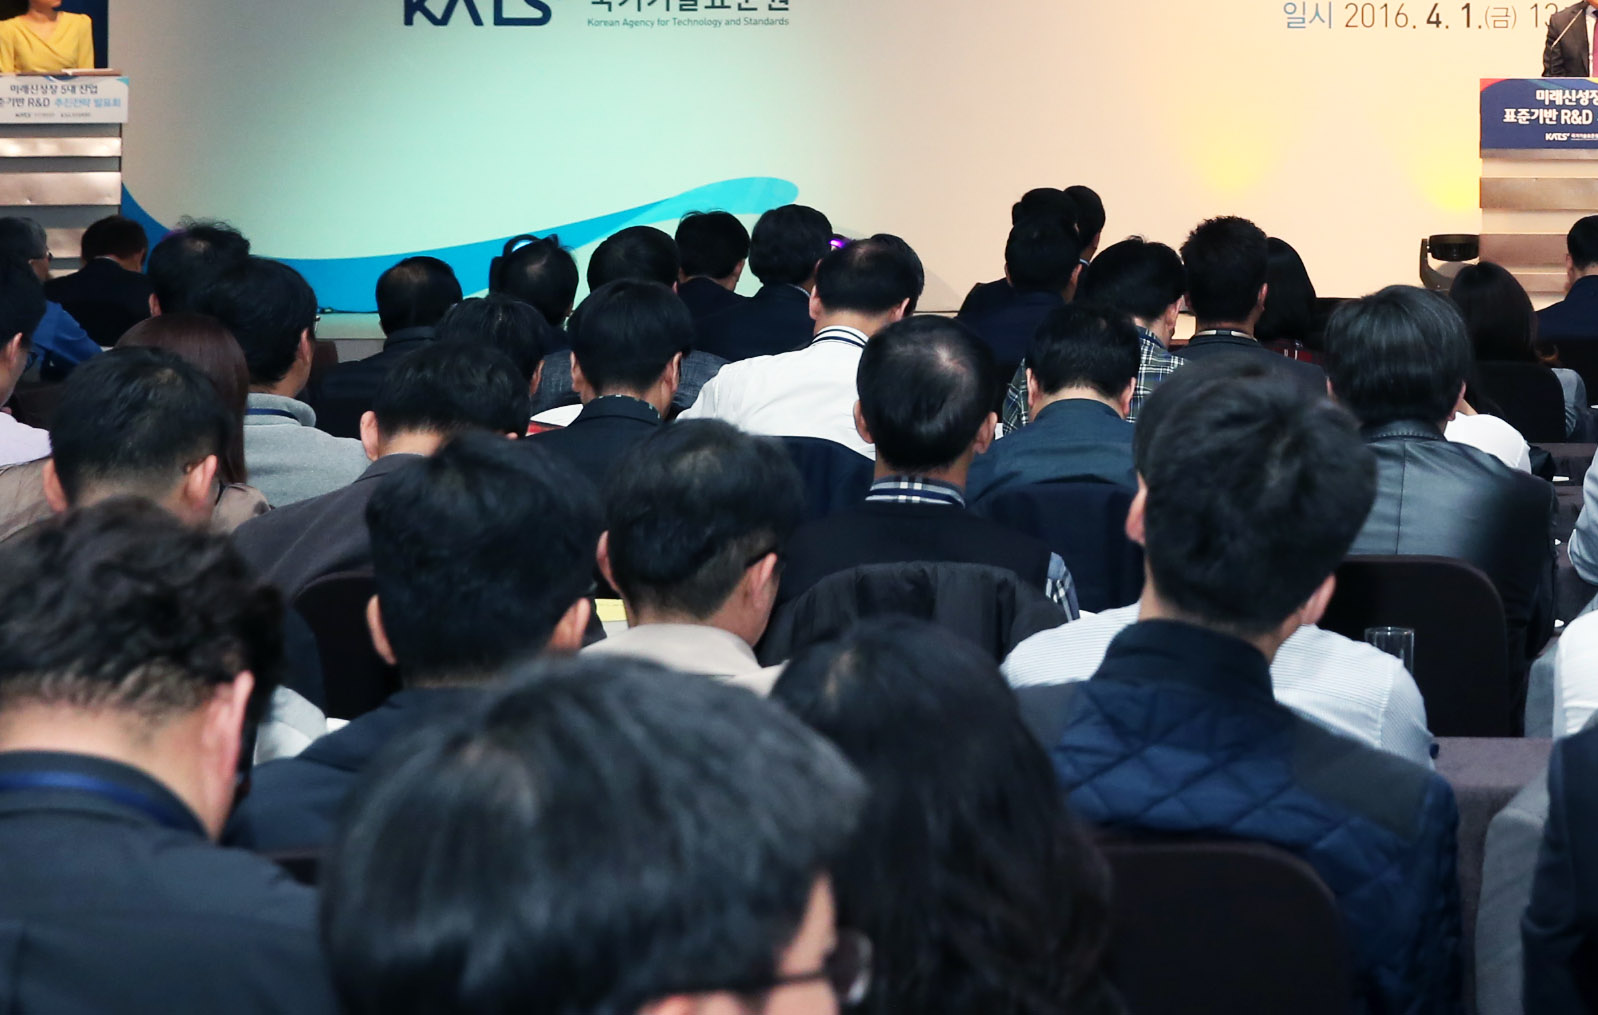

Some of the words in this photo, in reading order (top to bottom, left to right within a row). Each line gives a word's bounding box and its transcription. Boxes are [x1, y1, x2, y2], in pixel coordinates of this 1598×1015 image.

[1283, 1, 1332, 29] 일시
[1345, 3, 1417, 29] 2016.
[588, 18, 620, 26] Korean
[622, 18, 654, 28] Agency
[657, 18, 670, 26] for
[673, 18, 722, 28] Technology
[725, 18, 741, 26] and
[744, 17, 789, 26] Standards
[27, 97, 50, 107] R&D
[1503, 108, 1558, 125] 표준기반
[1560, 109, 1593, 125] R&D
[1545, 133, 1569, 141] KATS
